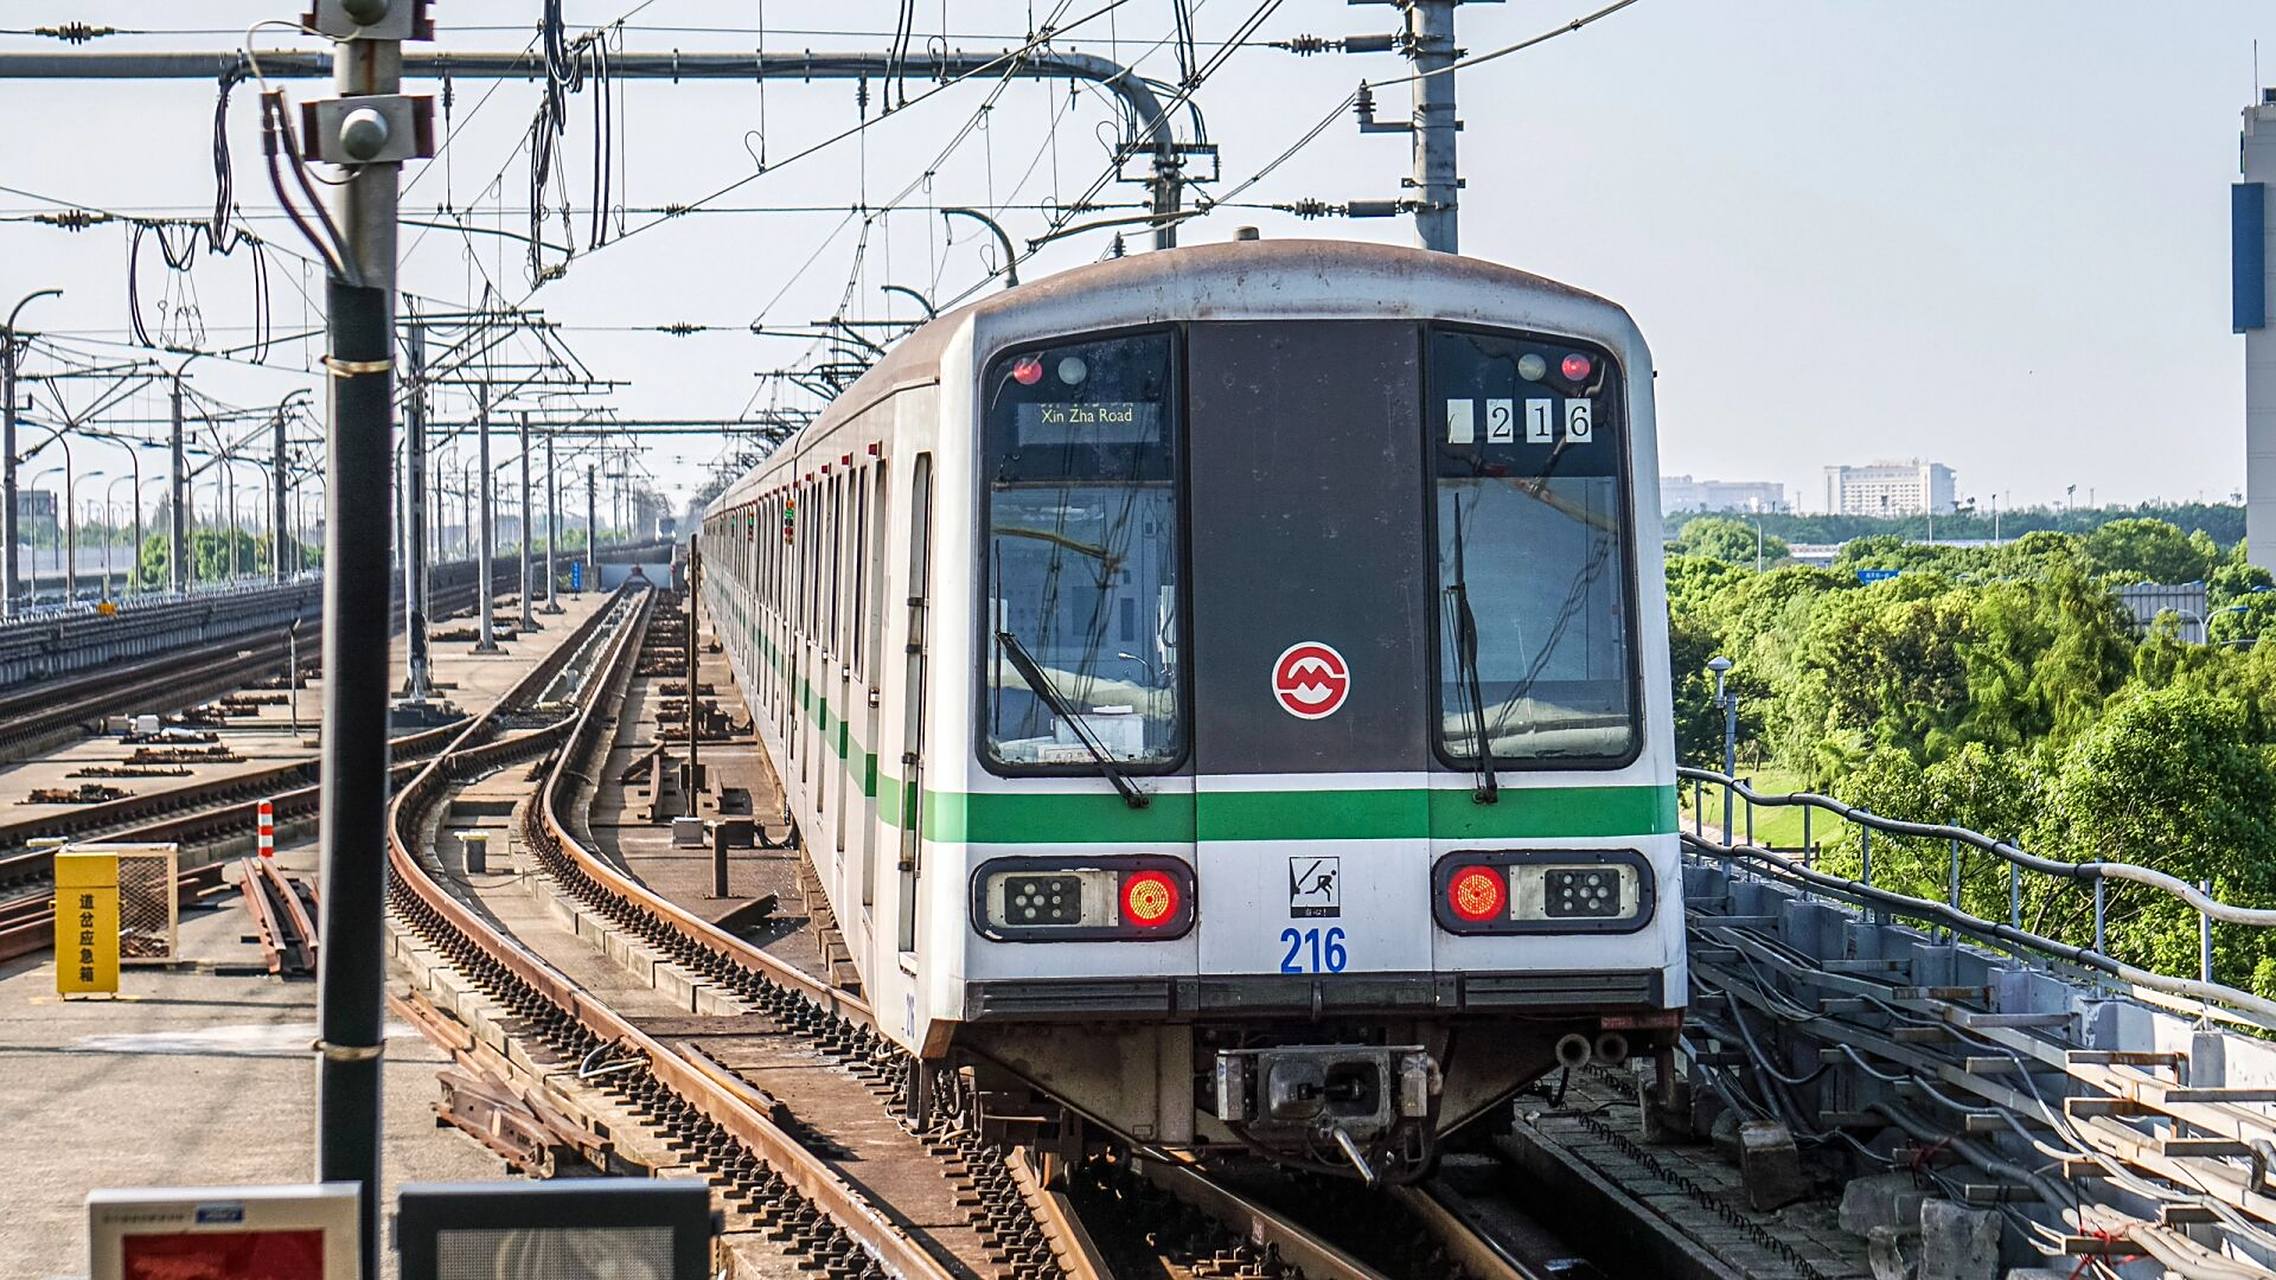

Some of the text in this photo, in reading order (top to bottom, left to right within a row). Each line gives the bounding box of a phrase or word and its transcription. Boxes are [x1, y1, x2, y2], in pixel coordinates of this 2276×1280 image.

[1041, 408, 1132, 423] Xin Zha Road
[79, 894, 94, 982] 道岔应急箱
[1280, 927, 1347, 973] 216
